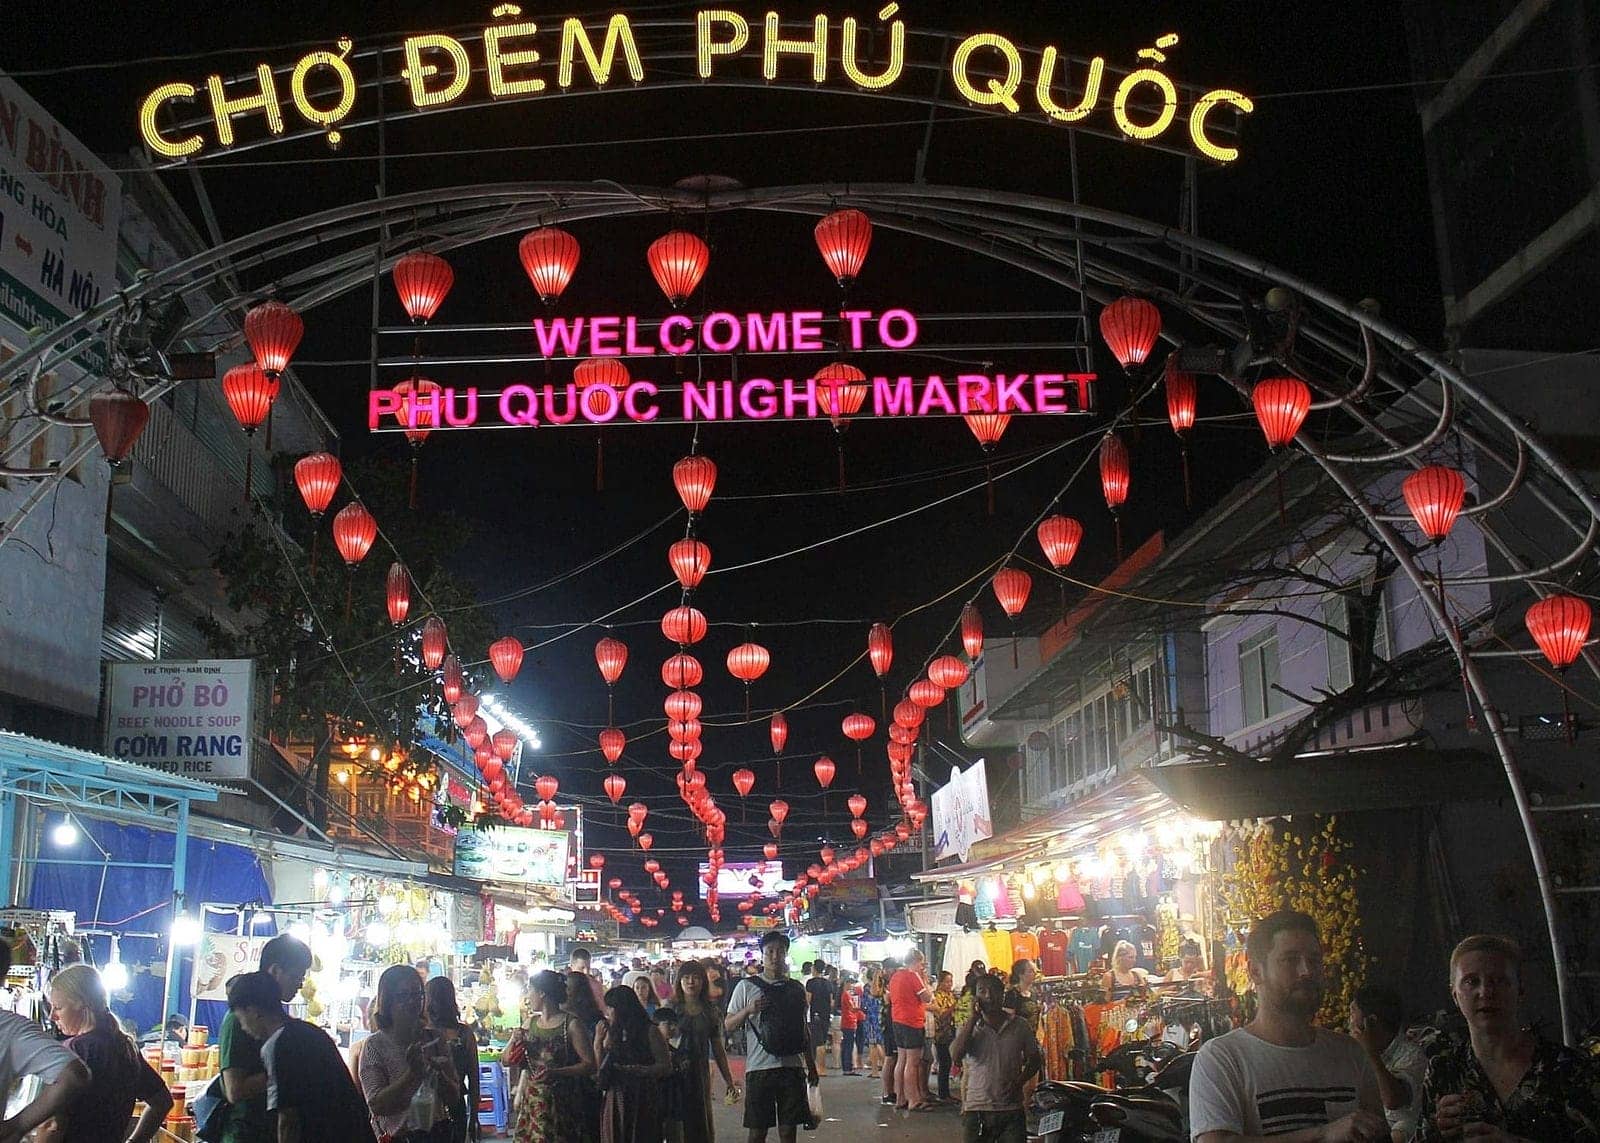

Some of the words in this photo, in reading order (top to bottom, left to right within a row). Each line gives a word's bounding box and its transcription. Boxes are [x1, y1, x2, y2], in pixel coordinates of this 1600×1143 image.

[139, 37, 357, 157] CHỢ
[401, 4, 645, 107] ĐÊM
[697, 2, 905, 90] PHÚ
[951, 33, 1255, 162] QUỐC
[40, 248, 65, 297] HÀ
[533, 311, 824, 358] WELCOME
[844, 309, 919, 349] TO
[368, 387, 479, 430] PHU
[499, 382, 660, 428] QUOC
[682, 378, 848, 421] NIGHT
[872, 373, 1098, 416] MARKET
[132, 677, 186, 708] PHỞ
[193, 679, 229, 707] BÒ
[118, 716, 150, 728] BEEF
[154, 716, 203, 728] NOODLE
[208, 715, 241, 727] SOUP
[114, 733, 168, 758] CƠM
[176, 735, 242, 757] RANG
[184, 761, 212, 772] RICE
